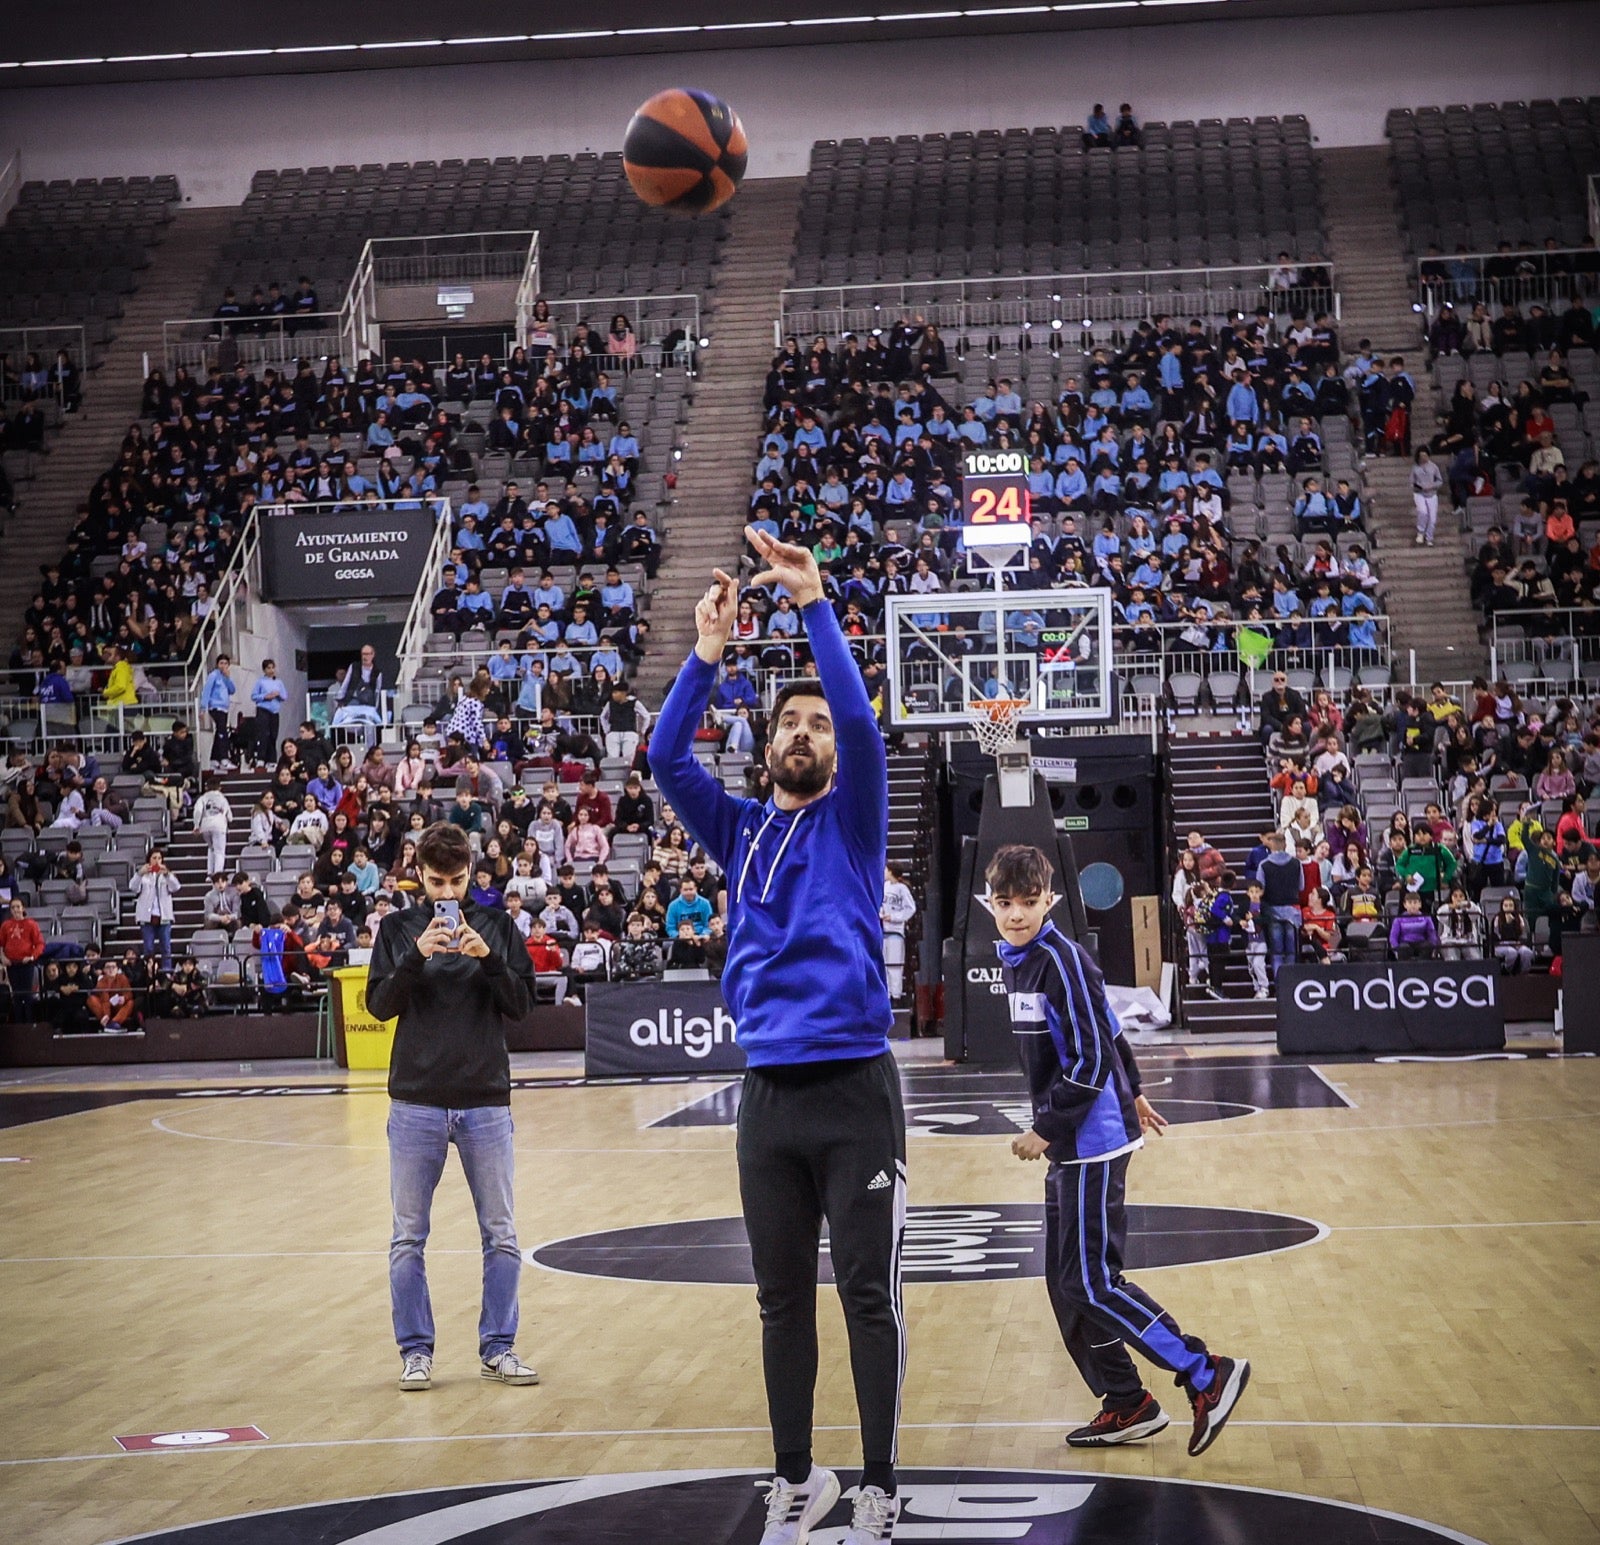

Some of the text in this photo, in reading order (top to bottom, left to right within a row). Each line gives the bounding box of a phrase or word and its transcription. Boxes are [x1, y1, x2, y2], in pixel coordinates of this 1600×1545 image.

[965, 453, 1022, 473] 10:00
[970, 487, 1021, 524] 24
[296, 531, 408, 546] AYUNTAMIENTO
[328, 548, 399, 563] GRANADA
[1293, 968, 1495, 1012] endesa
[345, 1023, 386, 1033] ENVASES
[629, 1007, 738, 1058] aligh
[867, 1180, 891, 1190] adidas
